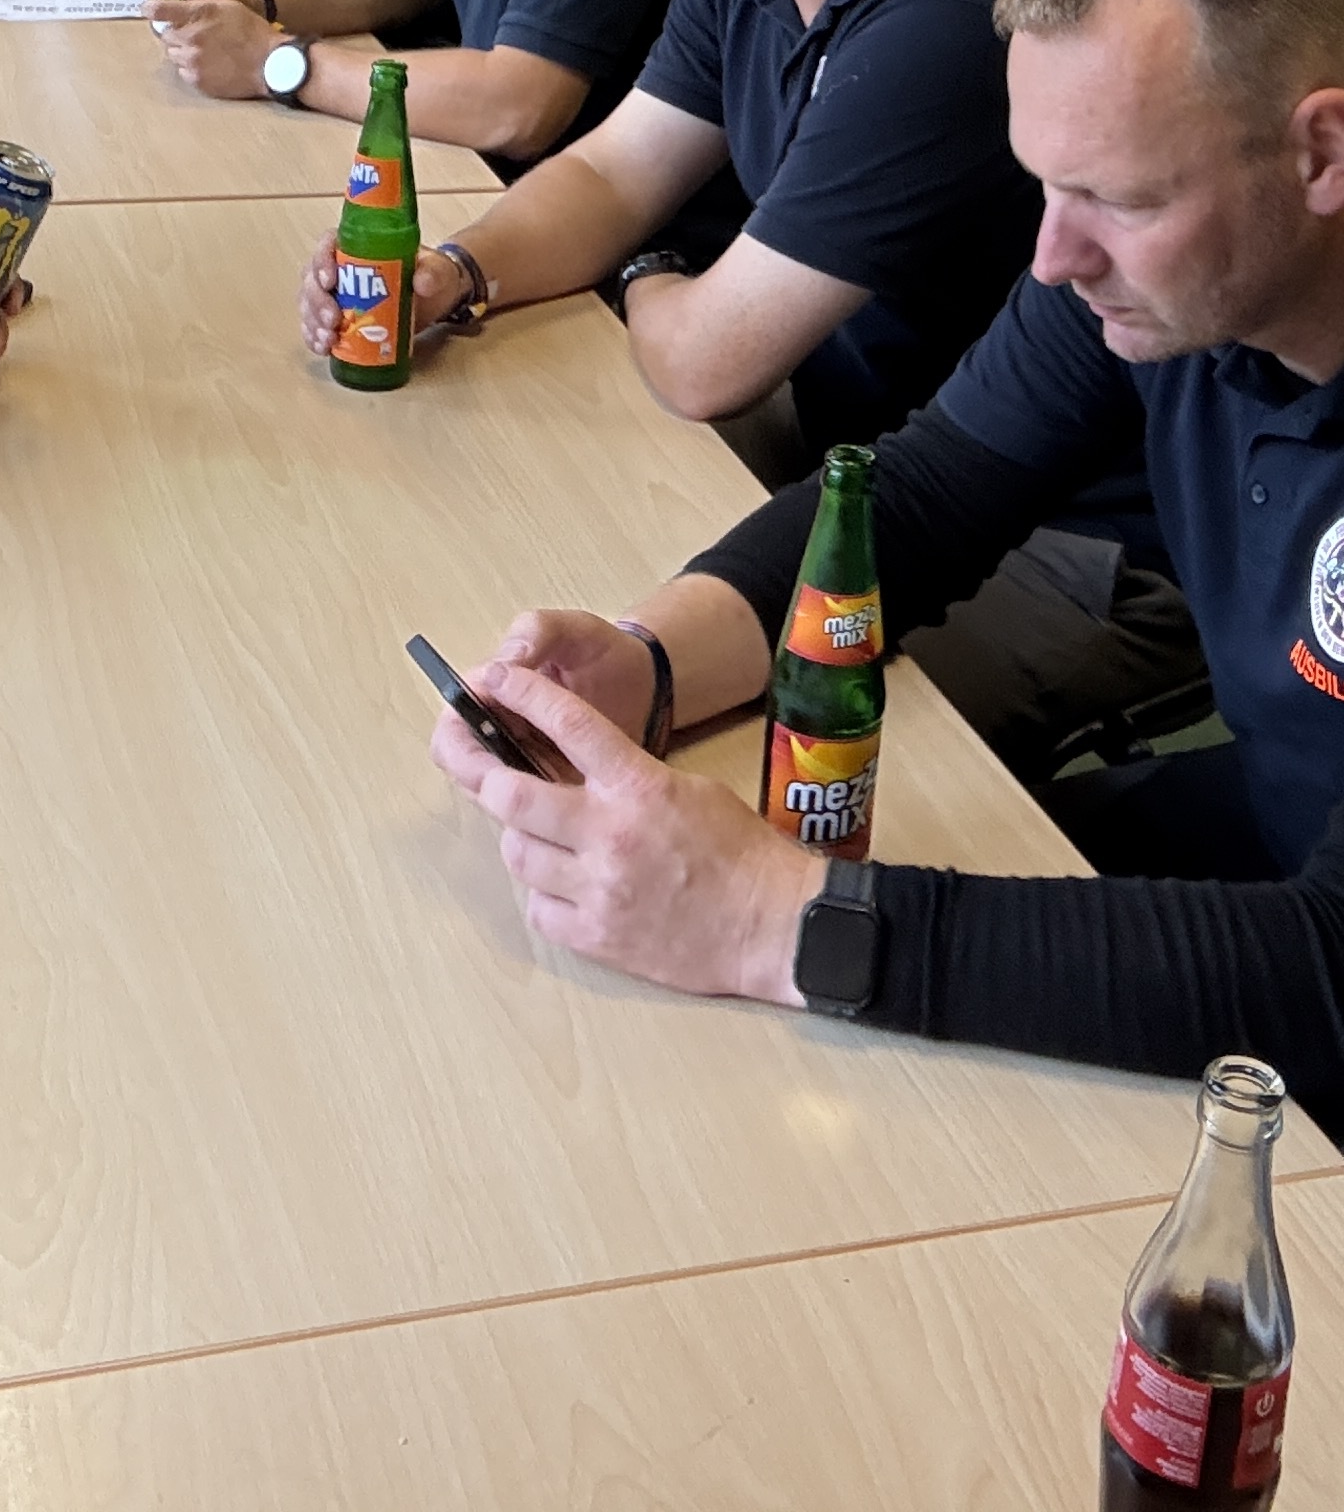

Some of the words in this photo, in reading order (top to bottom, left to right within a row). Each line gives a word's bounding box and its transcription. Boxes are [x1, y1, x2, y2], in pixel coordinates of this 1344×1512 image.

[350, 163, 380, 185] NTA
[338, 264, 388, 299] NTA
[824, 605, 876, 634] mezzo
[832, 626, 867, 649] mix
[785, 758, 879, 813] mezz
[799, 805, 867, 842] mix
